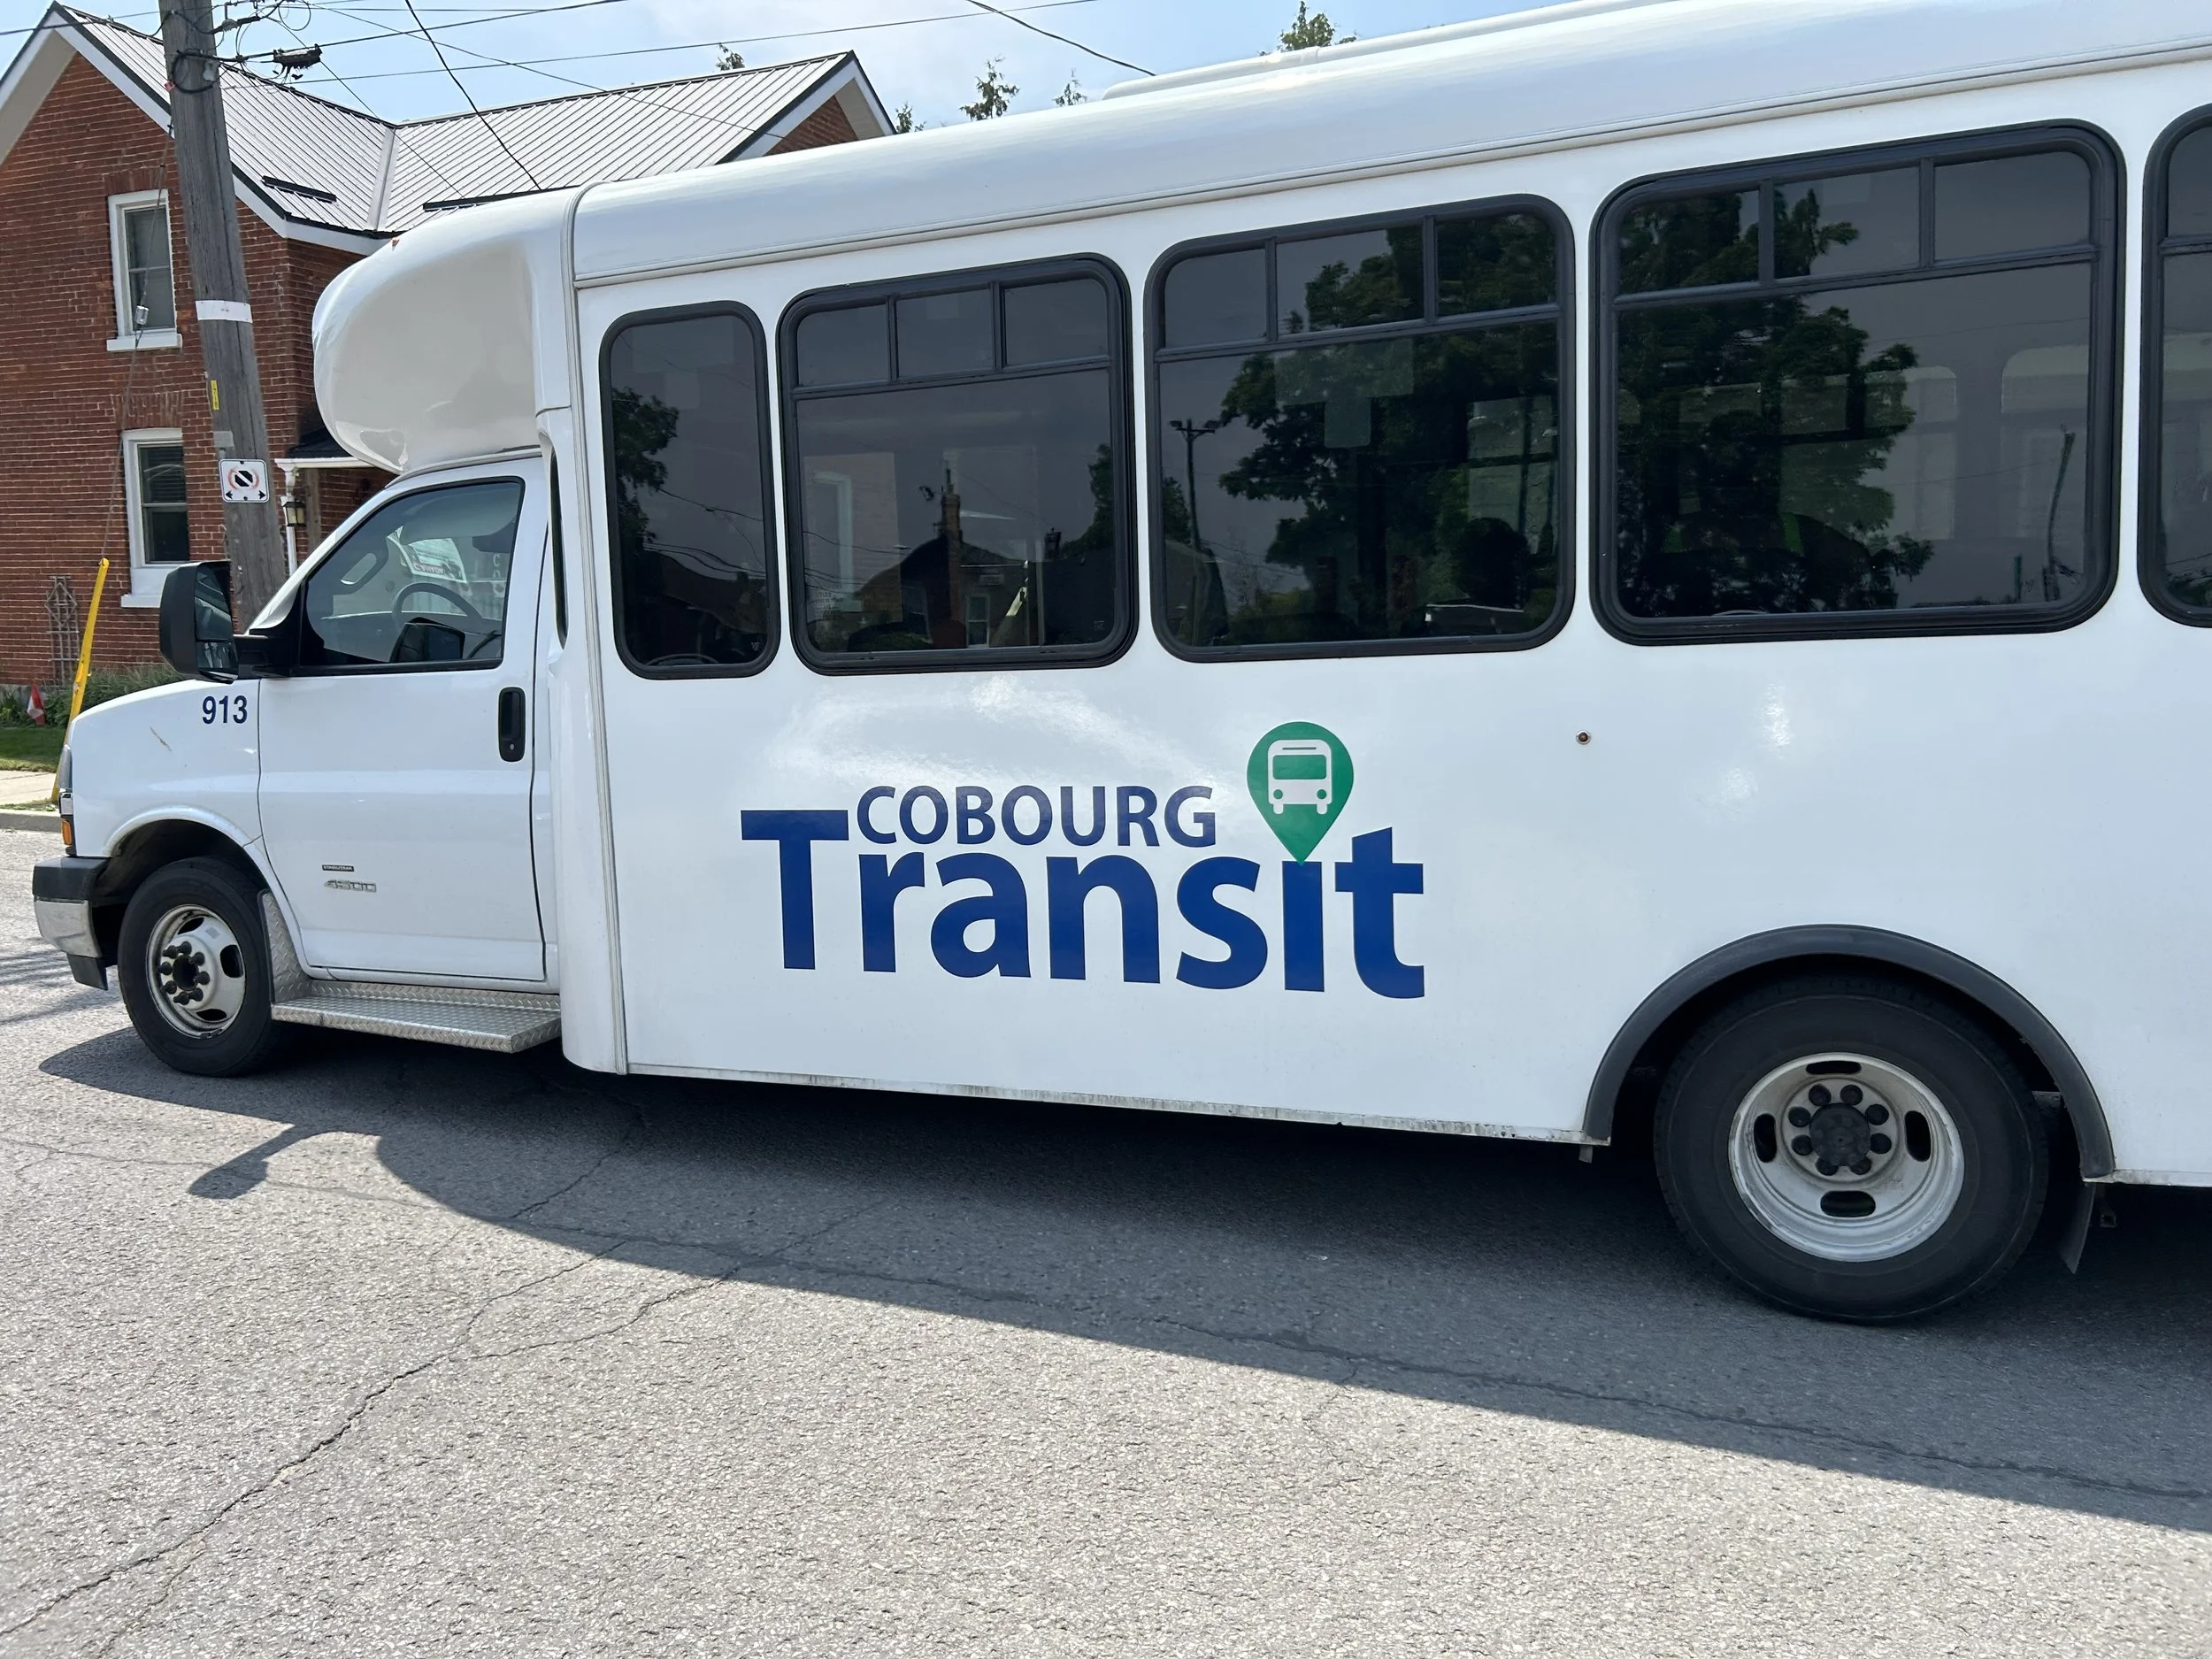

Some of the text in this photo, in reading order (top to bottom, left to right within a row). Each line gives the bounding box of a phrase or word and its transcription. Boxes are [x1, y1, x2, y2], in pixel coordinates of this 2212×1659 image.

[202, 695, 248, 725] 913
[856, 785, 1217, 848] COBOURG
[324, 879, 377, 893] 4500
[741, 809, 1425, 999] Transit
